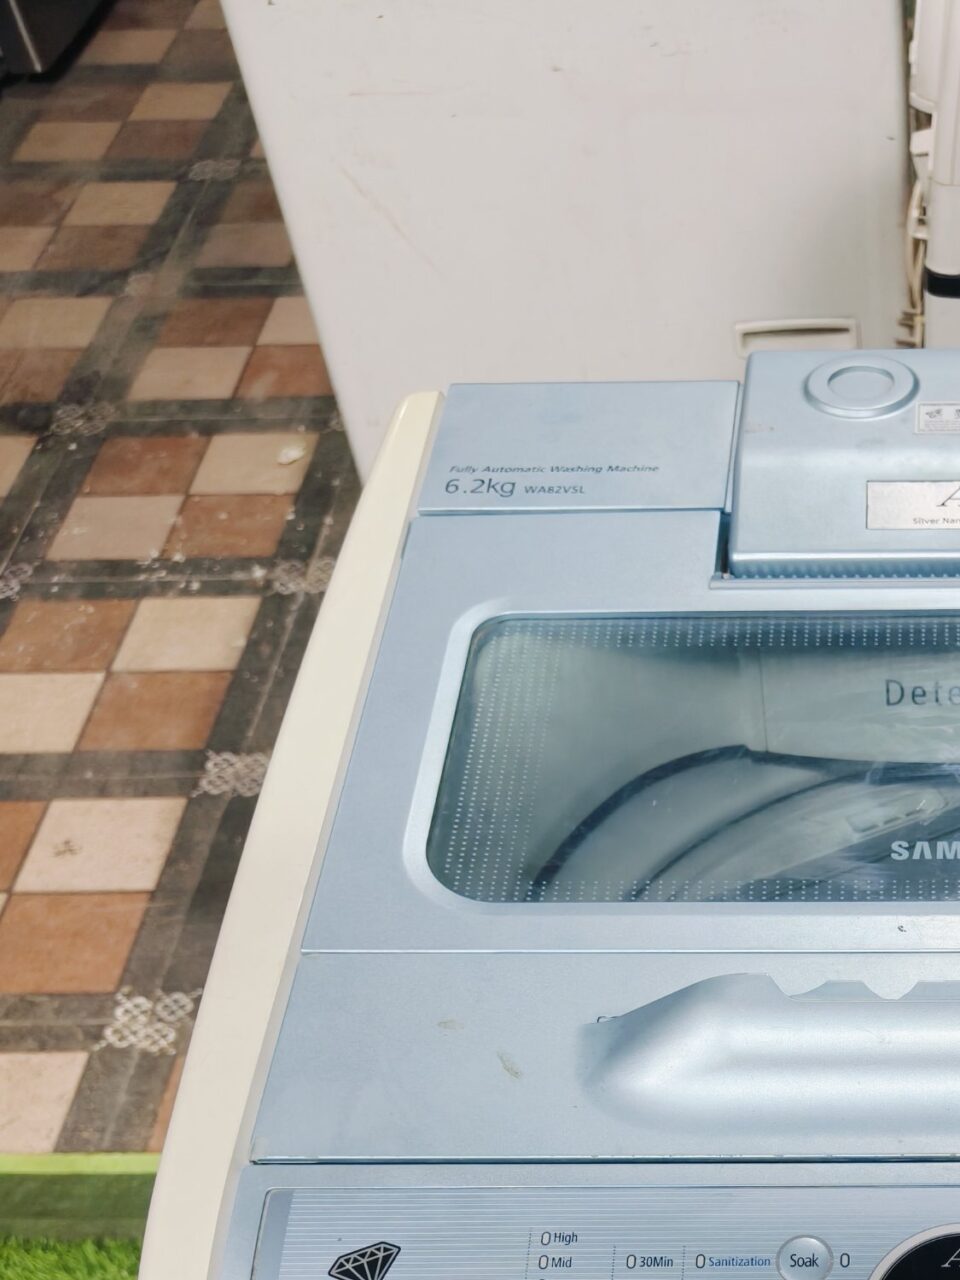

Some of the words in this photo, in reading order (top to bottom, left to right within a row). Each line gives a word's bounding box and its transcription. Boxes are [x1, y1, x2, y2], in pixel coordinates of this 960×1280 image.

[449, 465, 478, 474] Fully
[483, 465, 547, 473] Automatic
[550, 465, 603, 474] Washing
[607, 464, 660, 473] Machine
[445, 478, 516, 498] 6.2kg
[912, 517, 939, 525] Silver
[553, 1232, 578, 1246] High
[551, 1256, 572, 1268] Mid
[639, 1256, 674, 1268] 30Min
[708, 1255, 771, 1268] Sanitization
[790, 1254, 819, 1269] Soak
